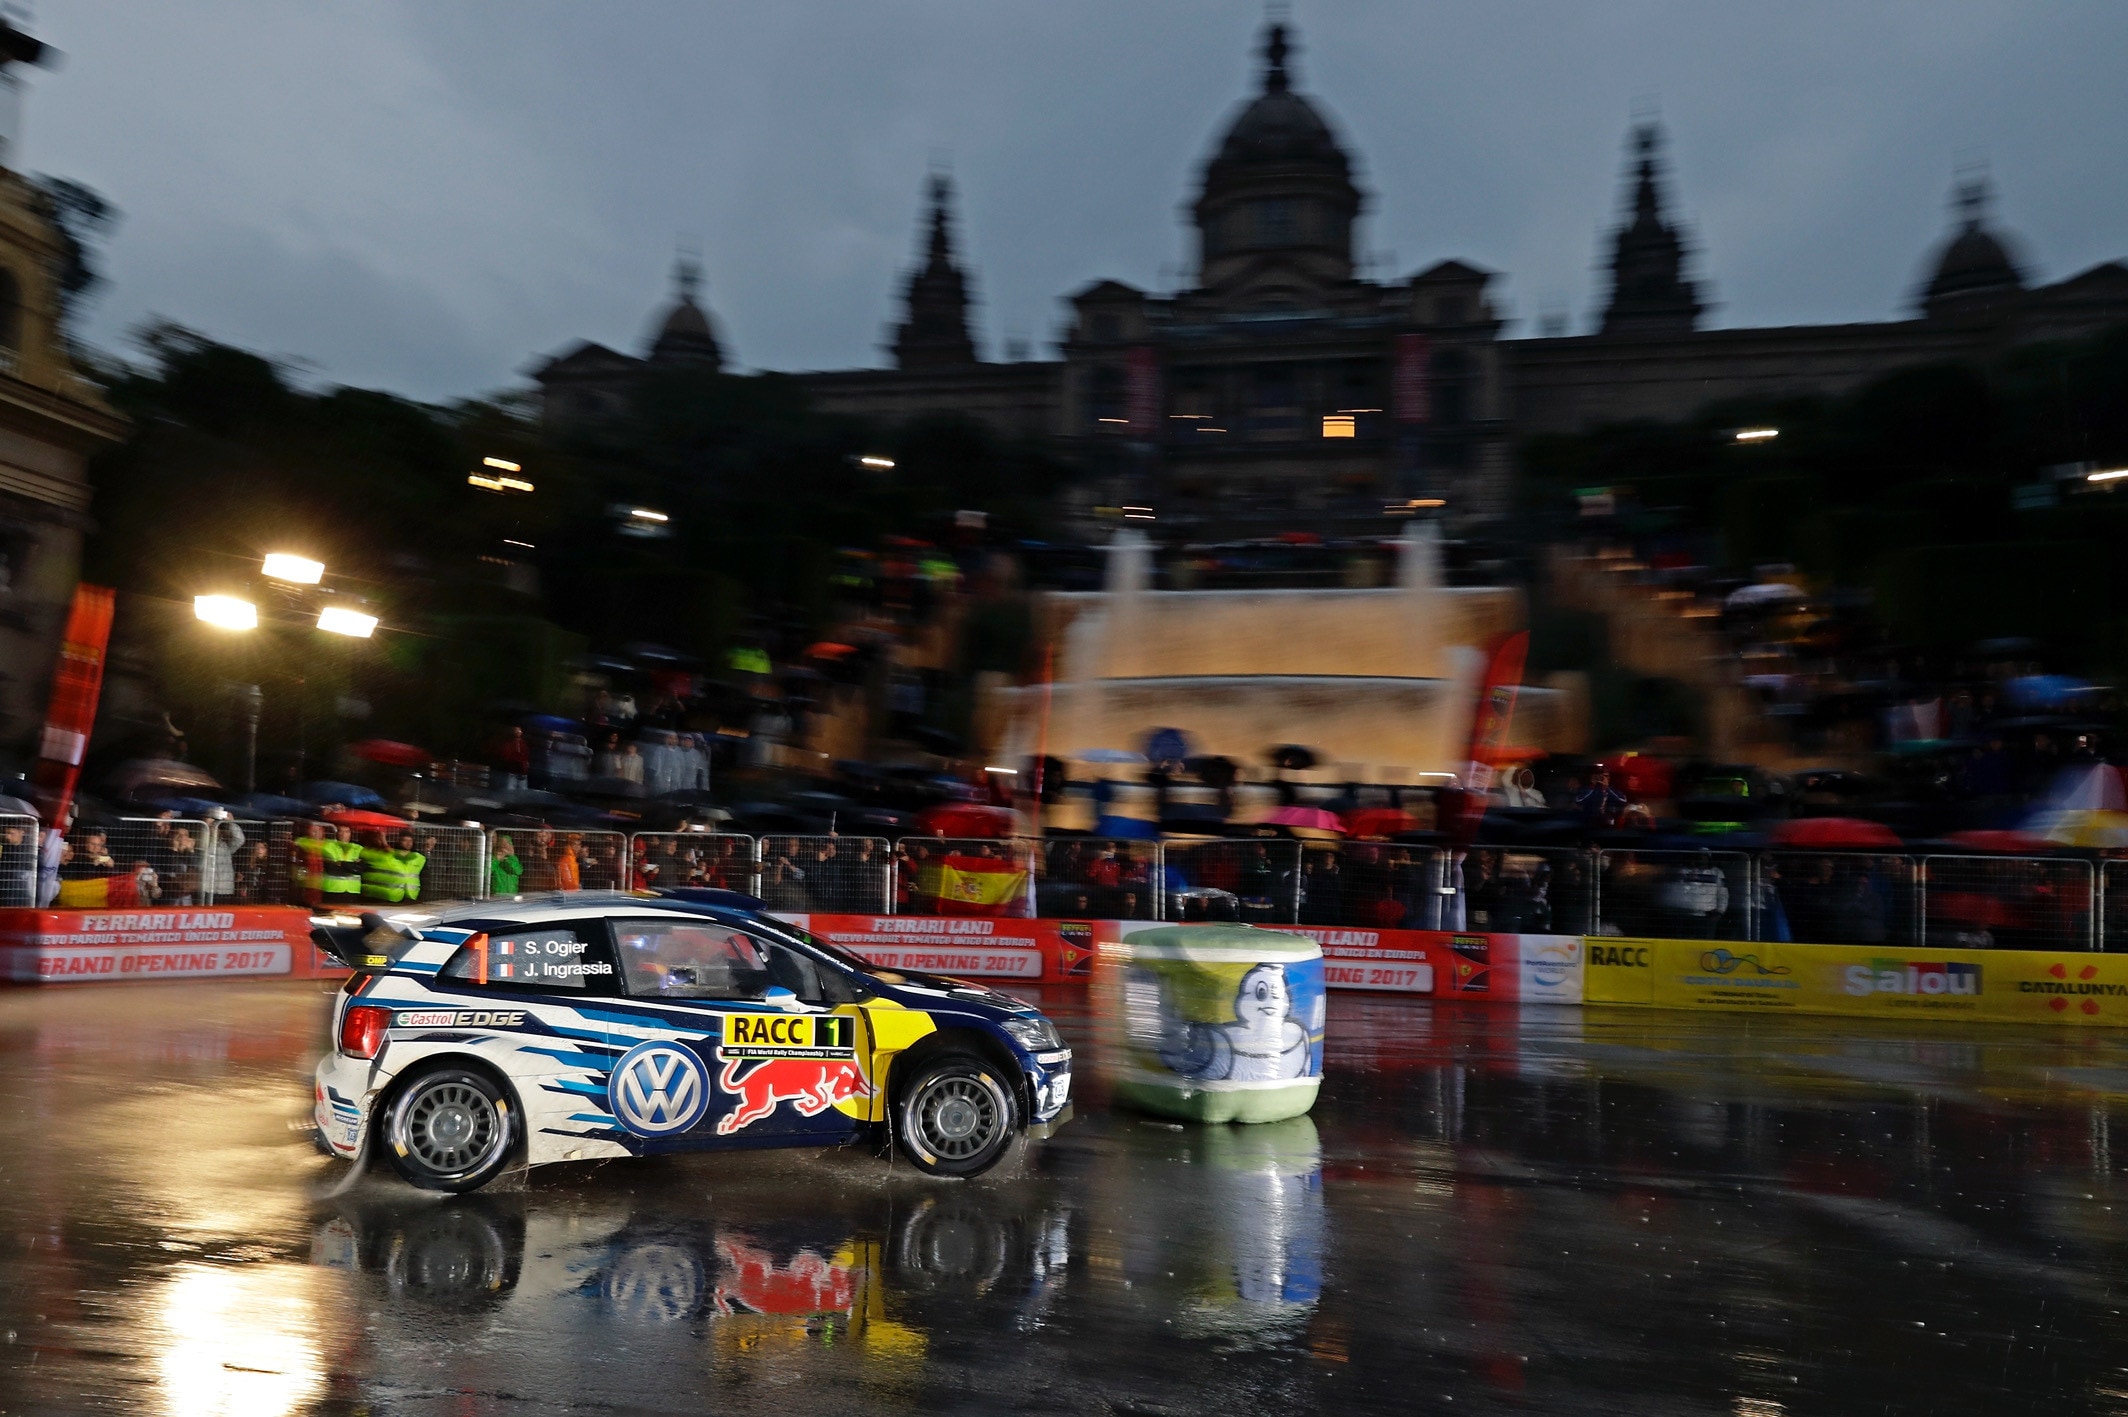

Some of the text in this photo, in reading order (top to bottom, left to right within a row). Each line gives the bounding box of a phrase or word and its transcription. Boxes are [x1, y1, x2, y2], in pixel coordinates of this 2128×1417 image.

[81, 913, 235, 931] FERRARI LAND
[873, 919, 994, 935] FERRARI LAND
[68, 933, 117, 945] PARQUE
[120, 931, 181, 943] TEMÁTICO
[185, 930, 220, 942] ÚNICO
[222, 931, 236, 941] EN
[240, 930, 284, 941] EUROPA
[864, 933, 901, 944] PARQUE
[903, 933, 952, 945] TEMÁTICO
[985, 936, 997, 946] EN
[998, 937, 1036, 947] EUROPA
[1329, 931, 1379, 946] LAND
[525, 941, 588, 957] S. Ogier
[1369, 949, 1383, 958] EN
[1384, 949, 1426, 960] EUROPA
[1592, 946, 1648, 967] RACC
[37, 951, 275, 975] GRAND OPENING 2017
[367, 956, 387, 964] OMP
[472, 933, 489, 985] 1
[903, 952, 979, 970] OPENING
[985, 955, 1028, 972] 2017
[525, 961, 612, 978] J. Ingrassia
[1370, 969, 1418, 986] 2017
[1845, 964, 1975, 996] Salou
[2019, 981, 2128, 996] CATALUNYA
[411, 1011, 527, 1027] Castrol EDGE
[734, 1017, 840, 1047] RACC 1
[788, 1050, 824, 1058] Championship
